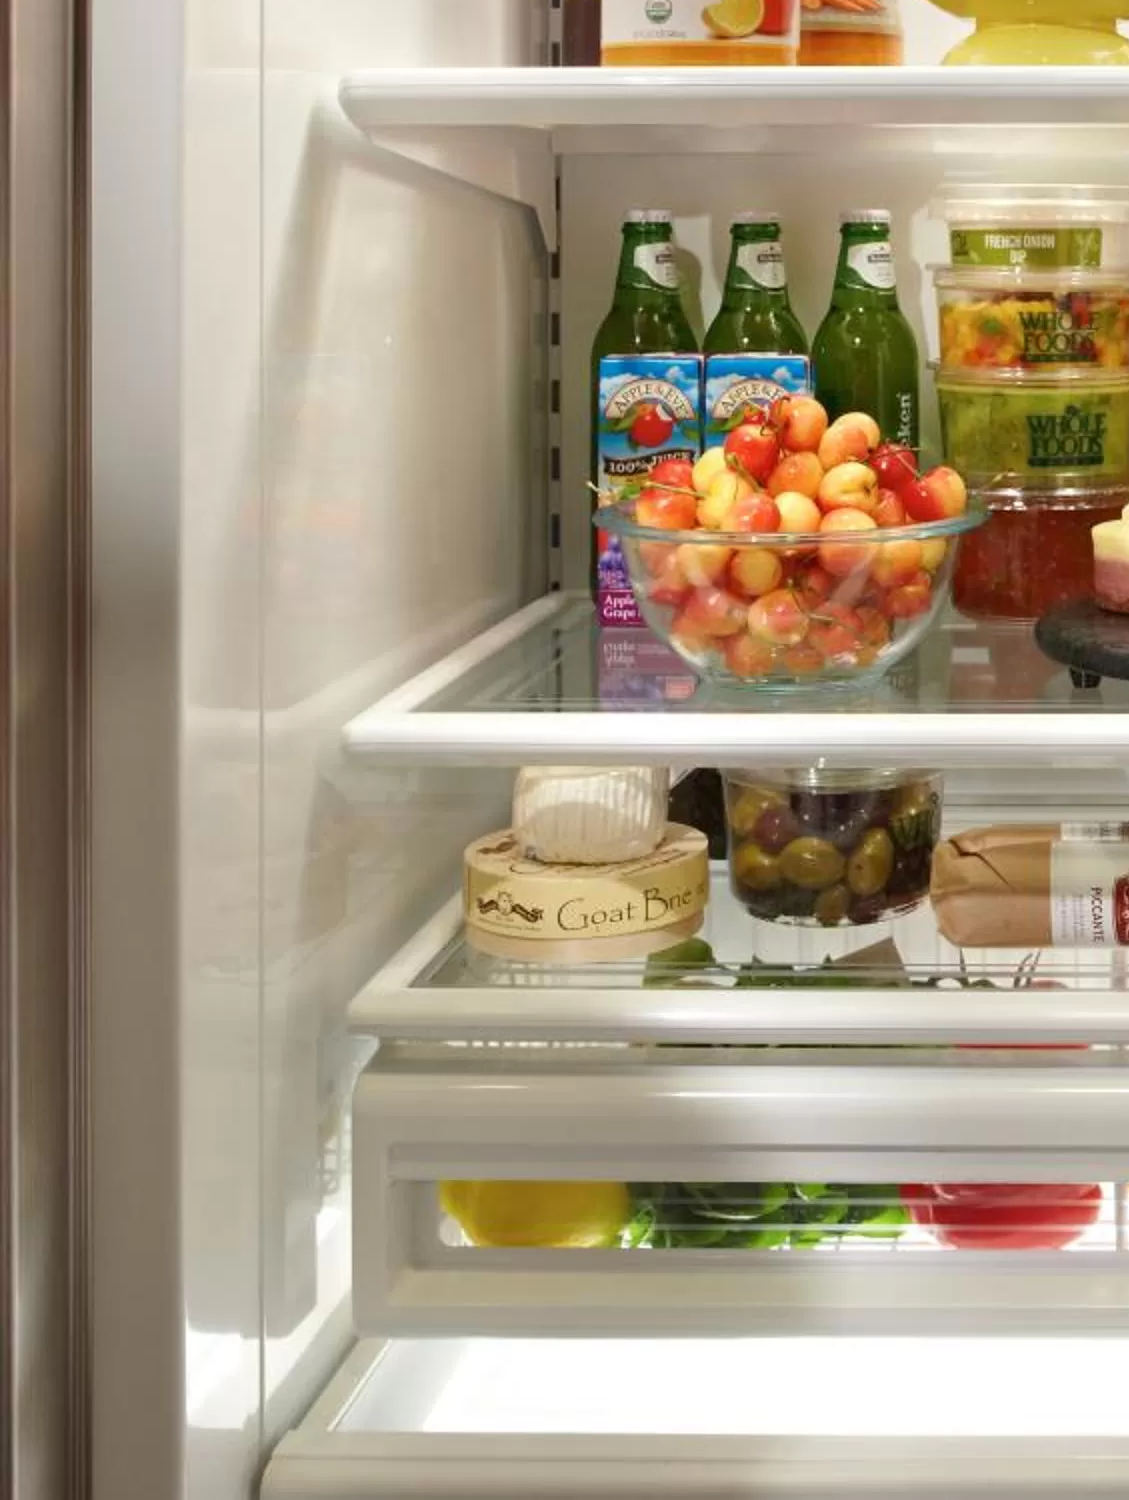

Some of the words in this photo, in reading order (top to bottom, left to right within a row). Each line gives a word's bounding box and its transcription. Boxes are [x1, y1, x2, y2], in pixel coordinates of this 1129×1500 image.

[1009, 249, 1027, 264] DIP
[1019, 310, 1101, 332] WHOLE
[1023, 331, 1096, 353] FOODS
[614, 382, 653, 416] APPLE
[665, 385, 689, 418] EVE
[1026, 410, 1108, 435] WHOLE
[1029, 434, 1104, 457] FOODS
[608, 457, 648, 474] 100%
[603, 595, 636, 609] Apple
[603, 608, 636, 621] Grape
[556, 897, 640, 931] Goat
[641, 886, 693, 922] Brie
[1091, 885, 1105, 943] PICCANTE
